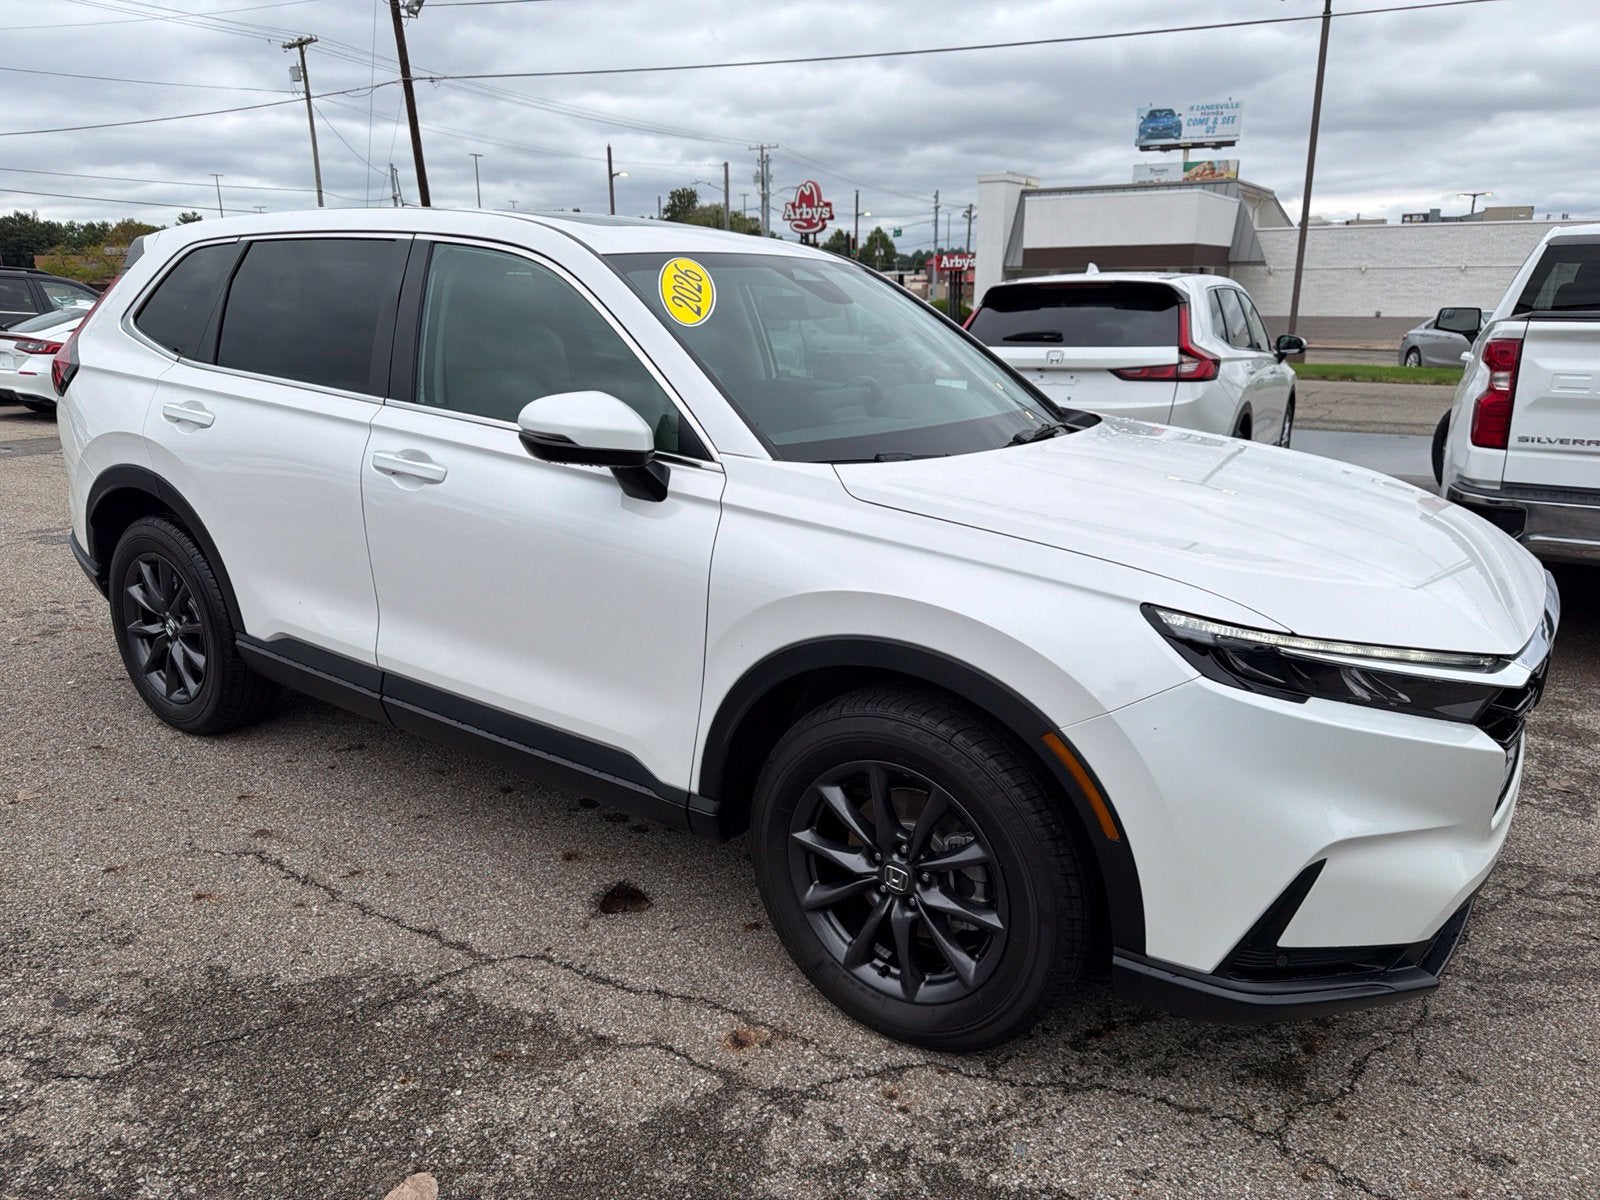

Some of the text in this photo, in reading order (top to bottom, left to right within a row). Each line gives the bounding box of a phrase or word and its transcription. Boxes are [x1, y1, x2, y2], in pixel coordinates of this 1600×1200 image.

[1187, 117, 1210, 127] COME
[1221, 115, 1237, 125] SEE
[1205, 125, 1217, 134] US
[783, 201, 831, 223] Arby's
[671, 262, 703, 317] 2026
